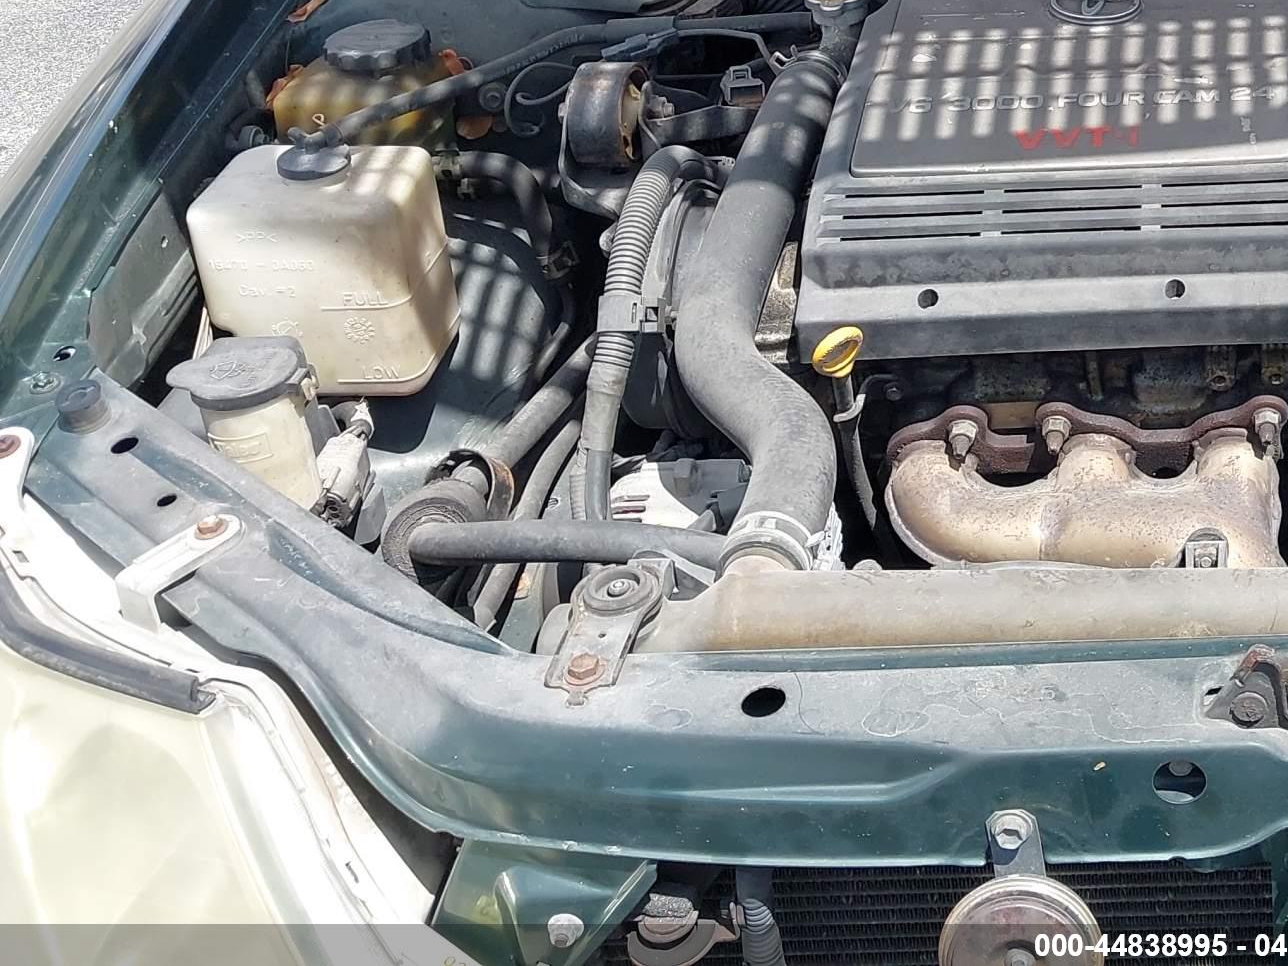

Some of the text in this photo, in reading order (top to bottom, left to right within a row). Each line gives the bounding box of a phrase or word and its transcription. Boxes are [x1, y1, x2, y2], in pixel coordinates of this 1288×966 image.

[889, 96, 933, 113] V6
[944, 94, 1044, 111] 3000
[1057, 90, 1146, 109] FOUR
[1152, 88, 1220, 105] CAM
[342, 290, 389, 306] FULL
[361, 362, 401, 380] LOW
